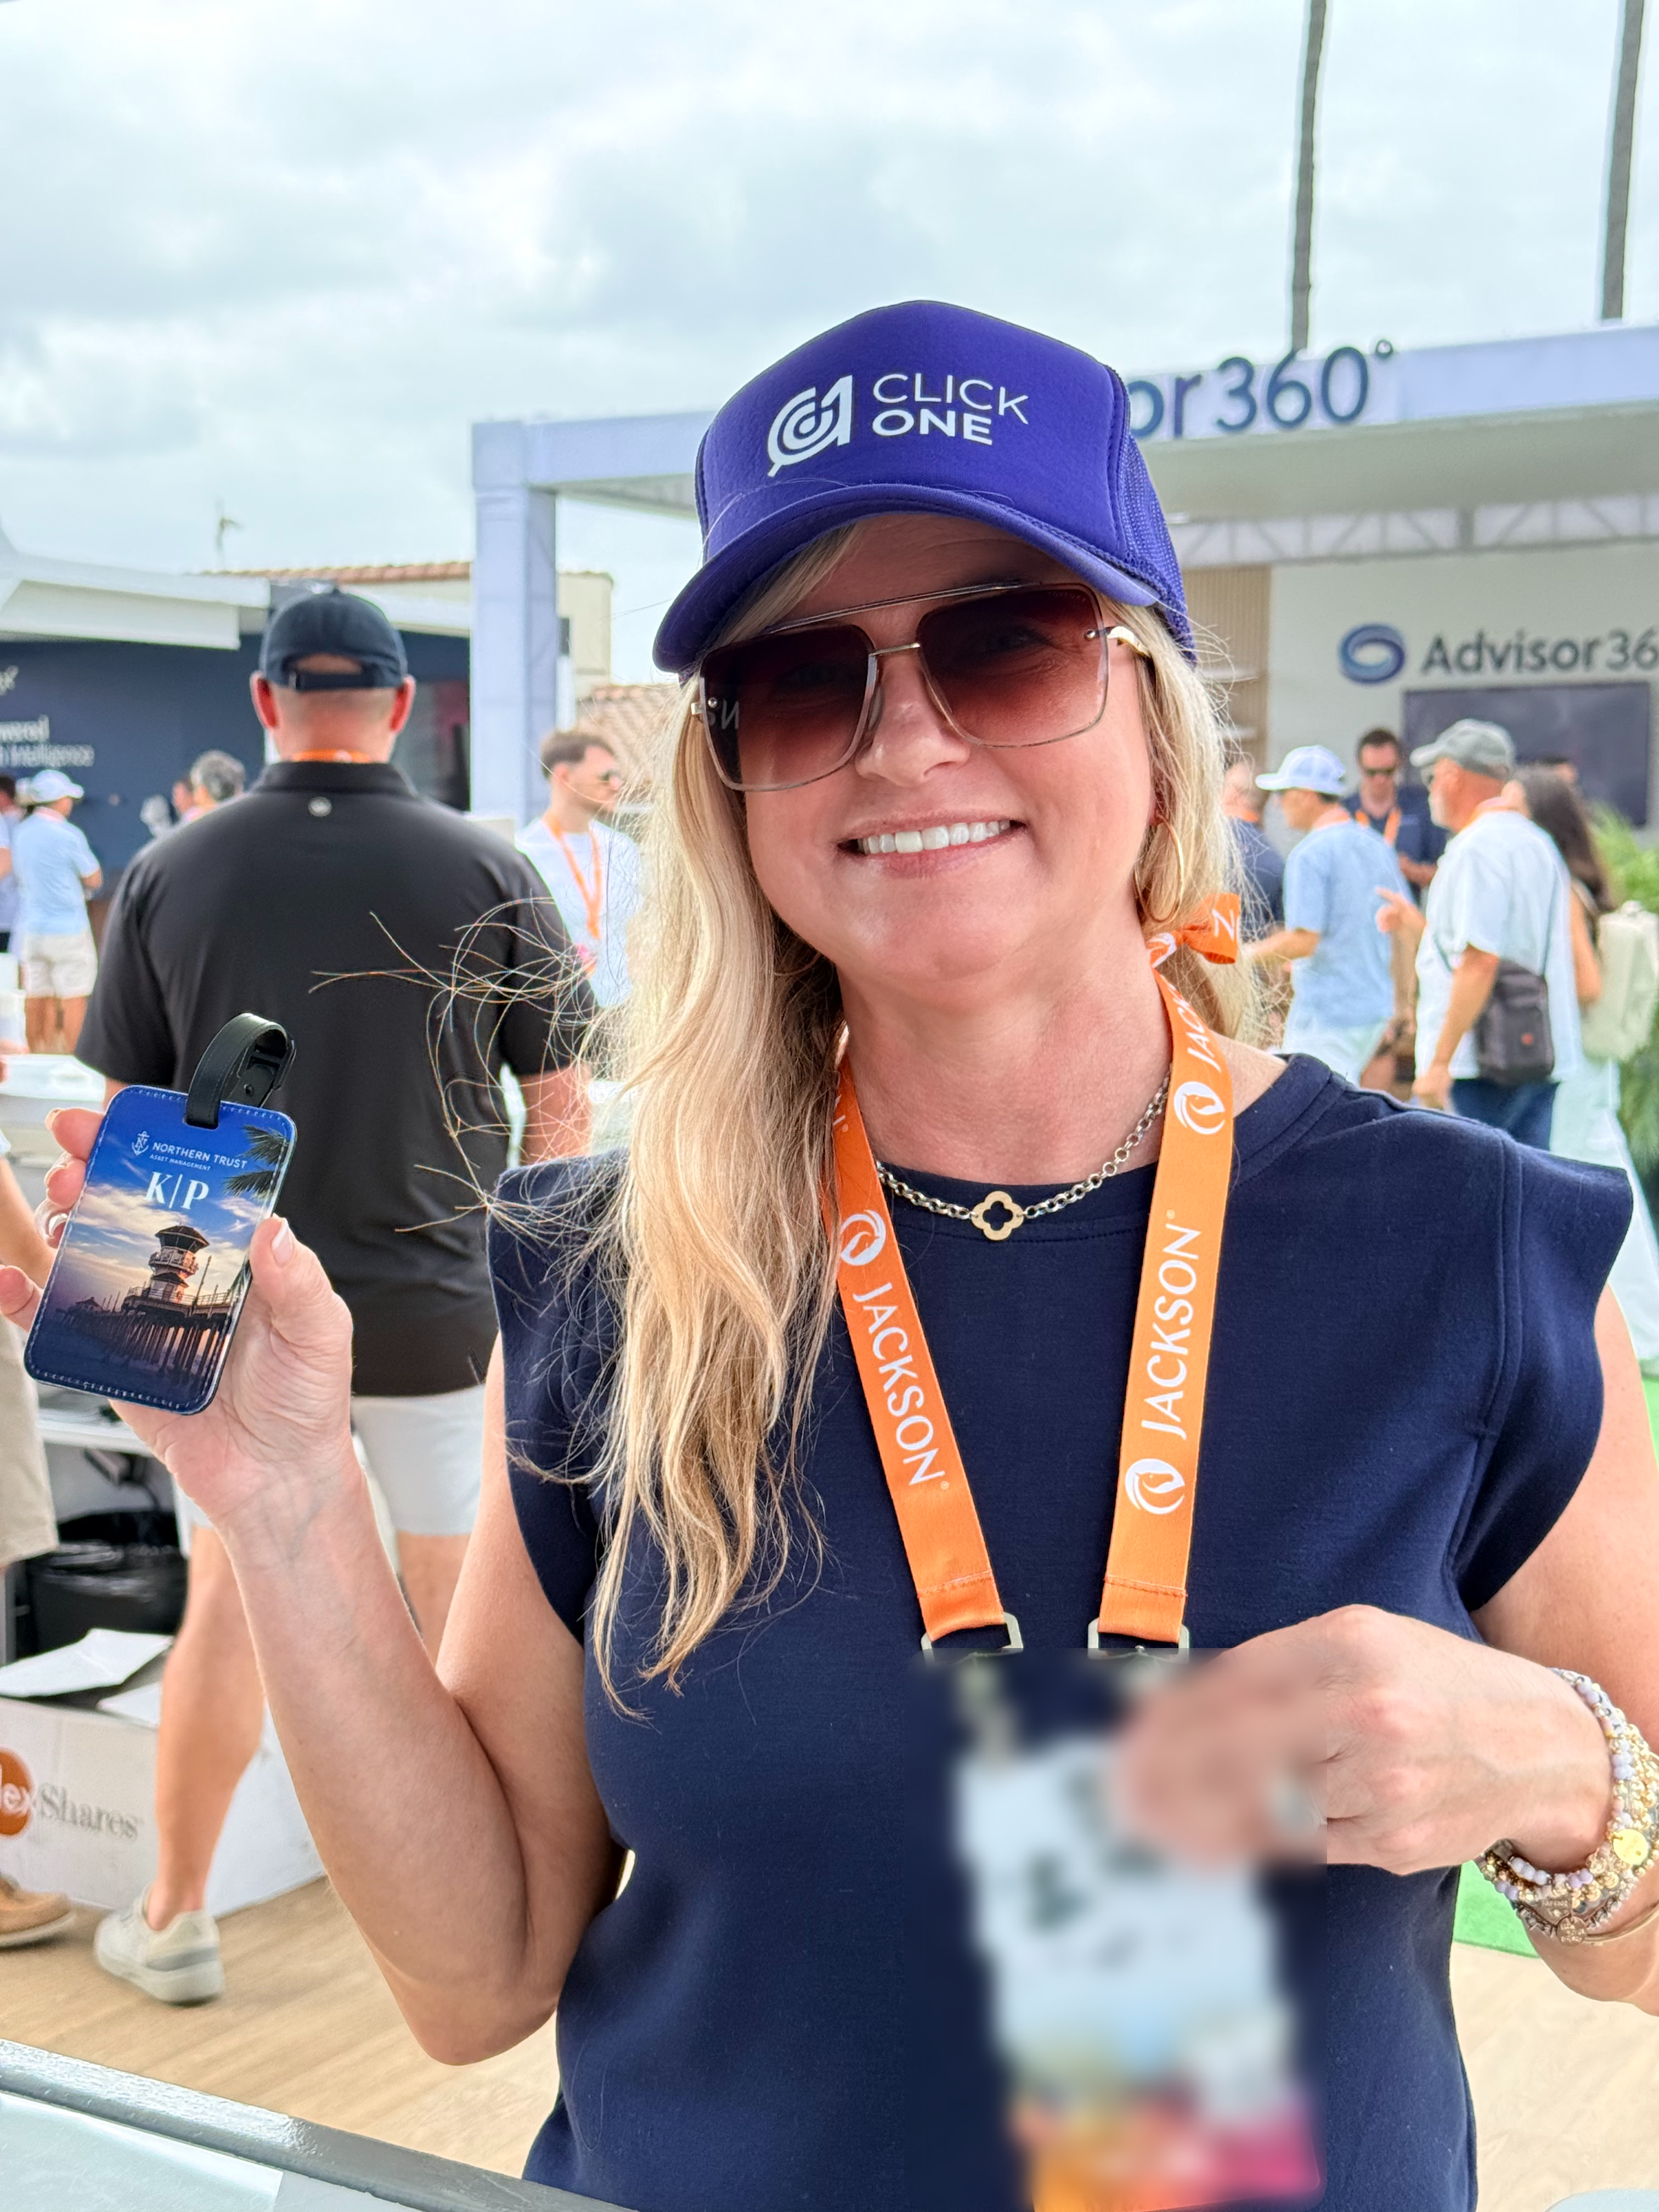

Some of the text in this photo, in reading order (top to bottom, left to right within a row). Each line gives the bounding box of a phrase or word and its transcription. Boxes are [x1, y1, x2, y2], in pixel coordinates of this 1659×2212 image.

[872, 373, 1029, 425] CLICK
[872, 409, 992, 445] ONE
[149, 1154, 211, 1171] ASSET MANAGEMENT
[152, 1142, 248, 1169] NORTHERN TRUST
